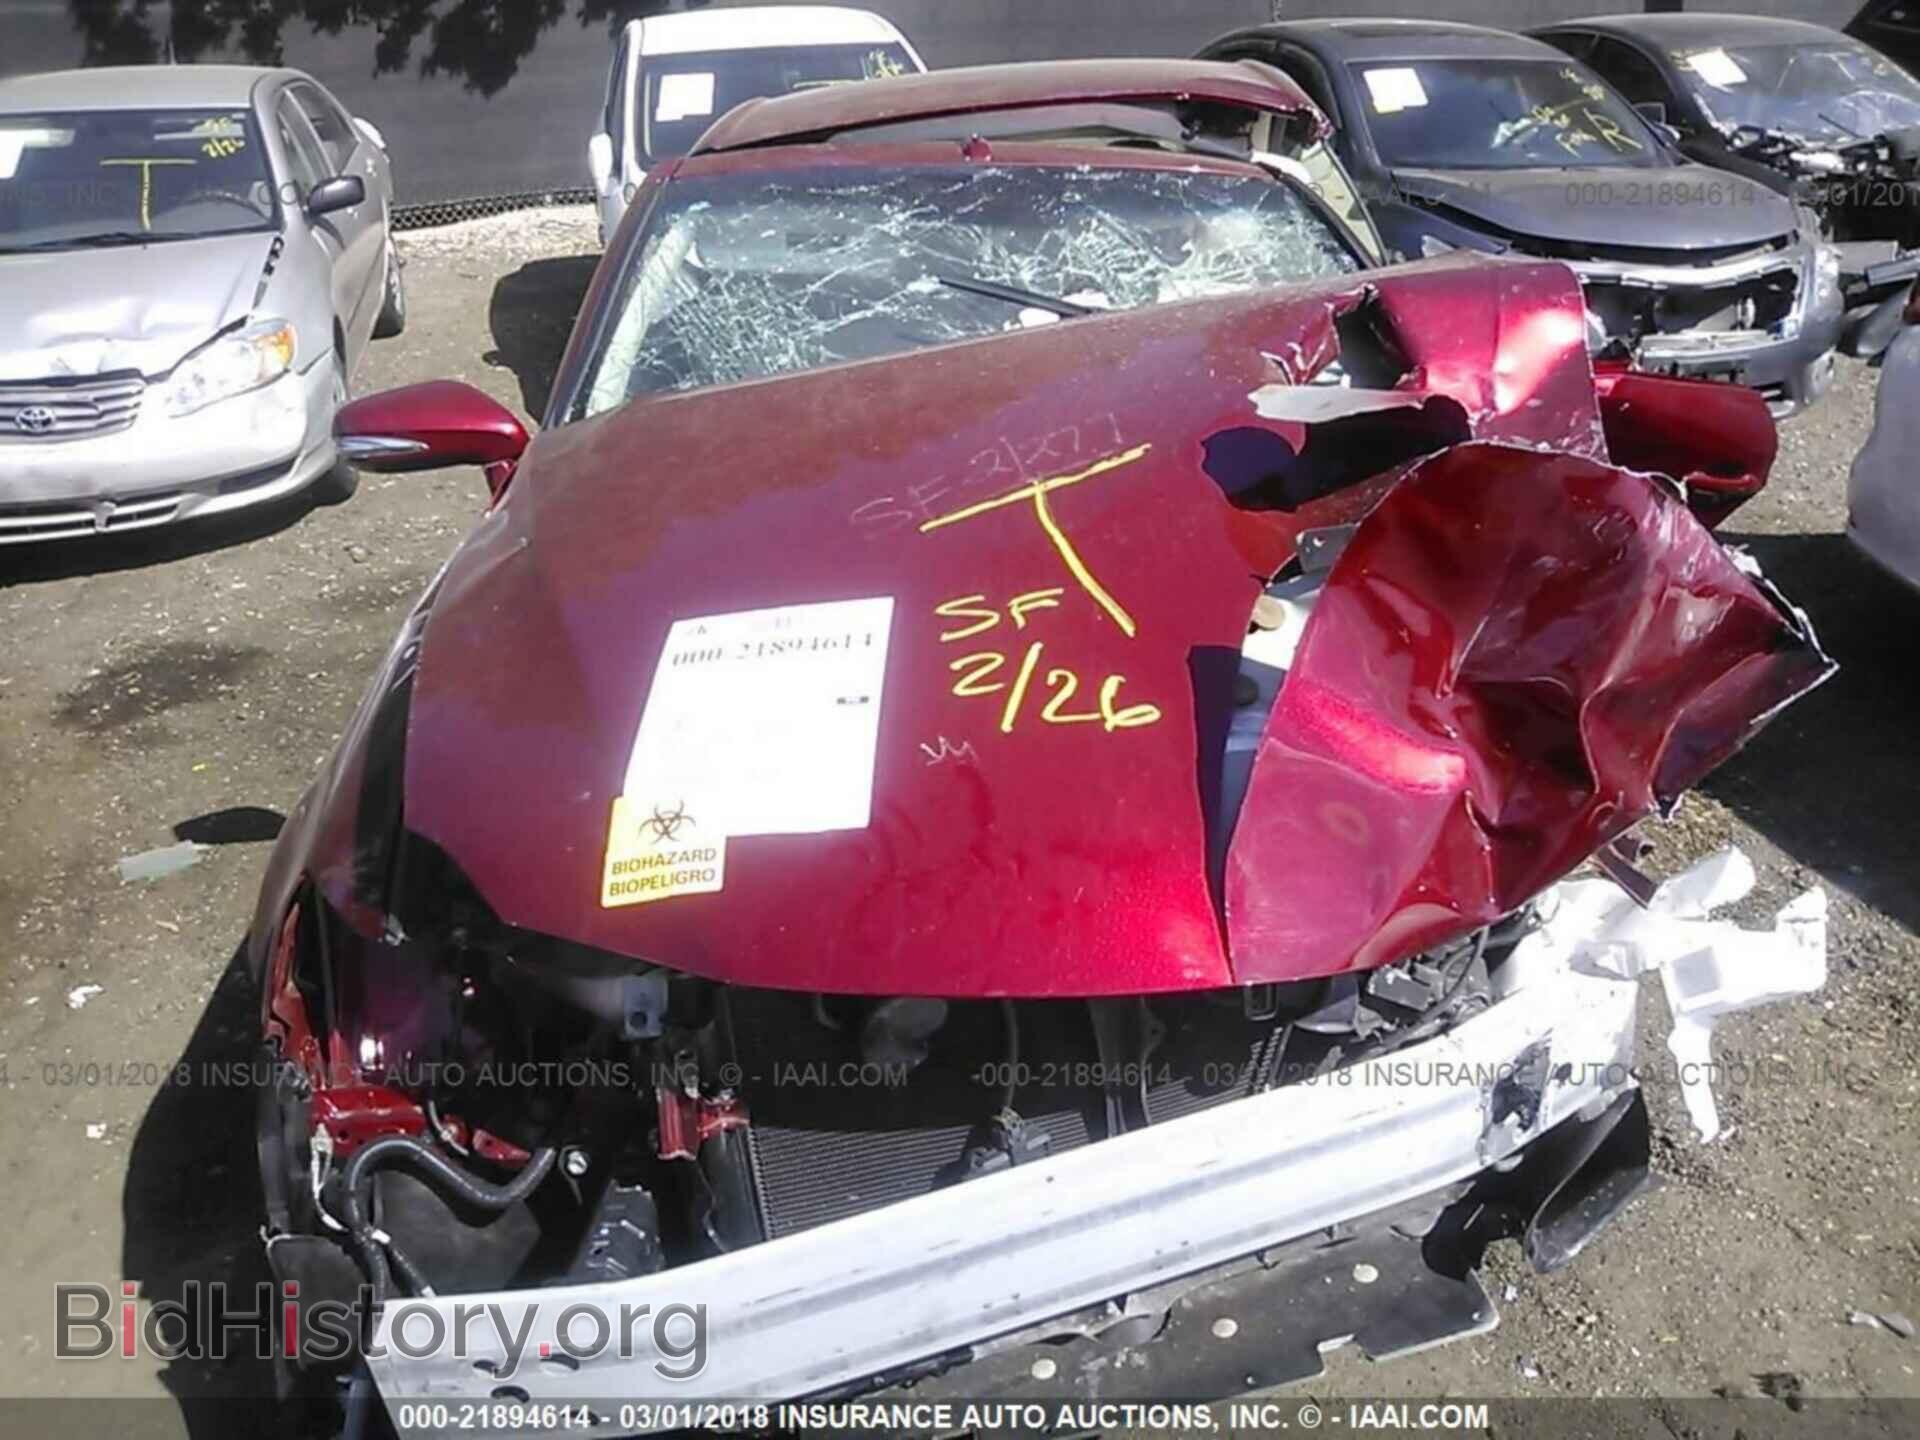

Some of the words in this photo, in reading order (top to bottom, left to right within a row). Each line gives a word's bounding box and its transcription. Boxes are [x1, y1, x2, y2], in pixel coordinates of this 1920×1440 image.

[935, 588, 1065, 642] SF
[949, 641, 1161, 732] 2/26
[611, 847, 718, 876] BIOHAZARD
[609, 868, 716, 897] BIOPELIGRO
